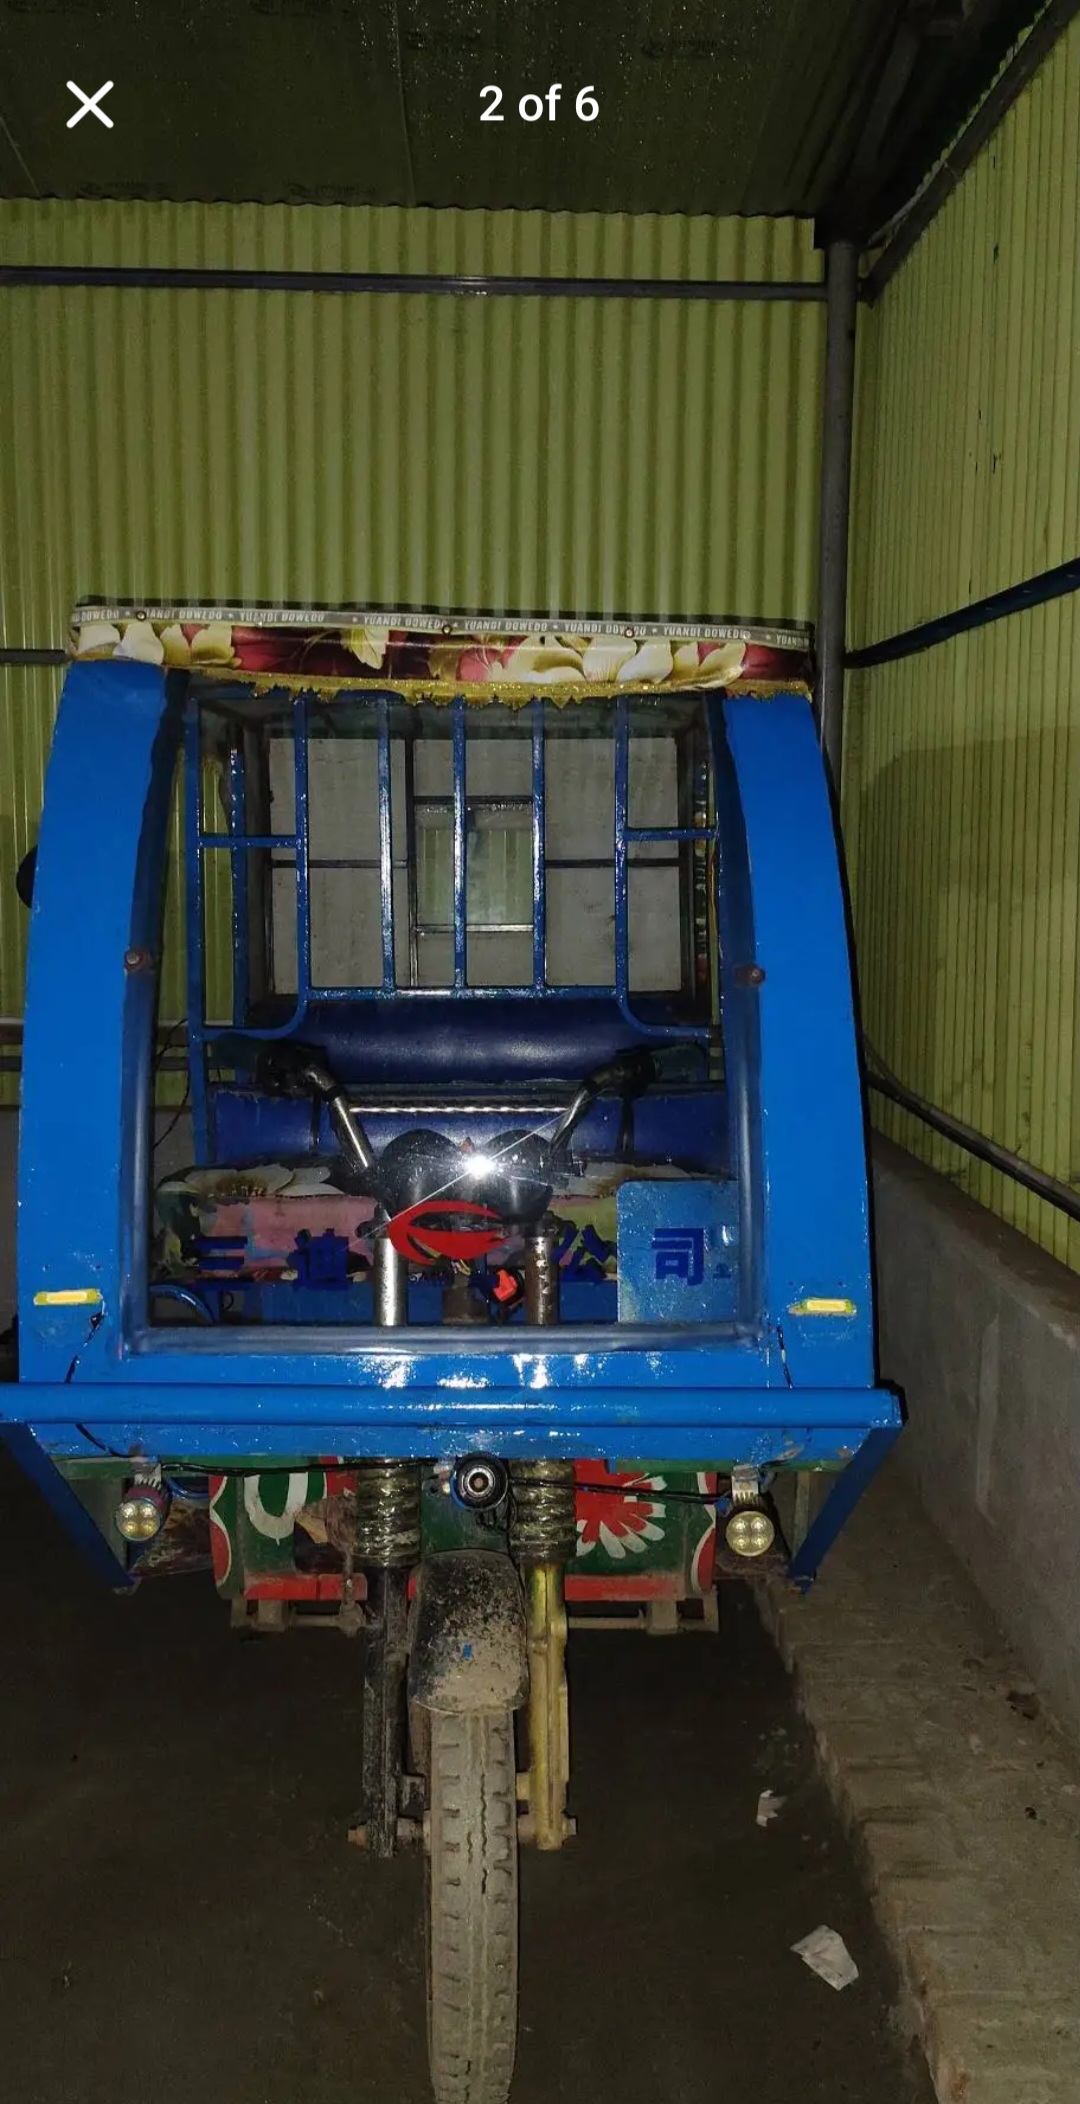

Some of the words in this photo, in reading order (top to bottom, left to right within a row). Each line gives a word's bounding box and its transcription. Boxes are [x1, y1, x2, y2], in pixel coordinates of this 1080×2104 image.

[364, 615, 401, 626] YUANDI
[464, 619, 501, 630] YUANDI
[564, 622, 602, 633] YUANDI
[664, 625, 701, 637] YUANDI
[551, 1219, 706, 1288] 公司
